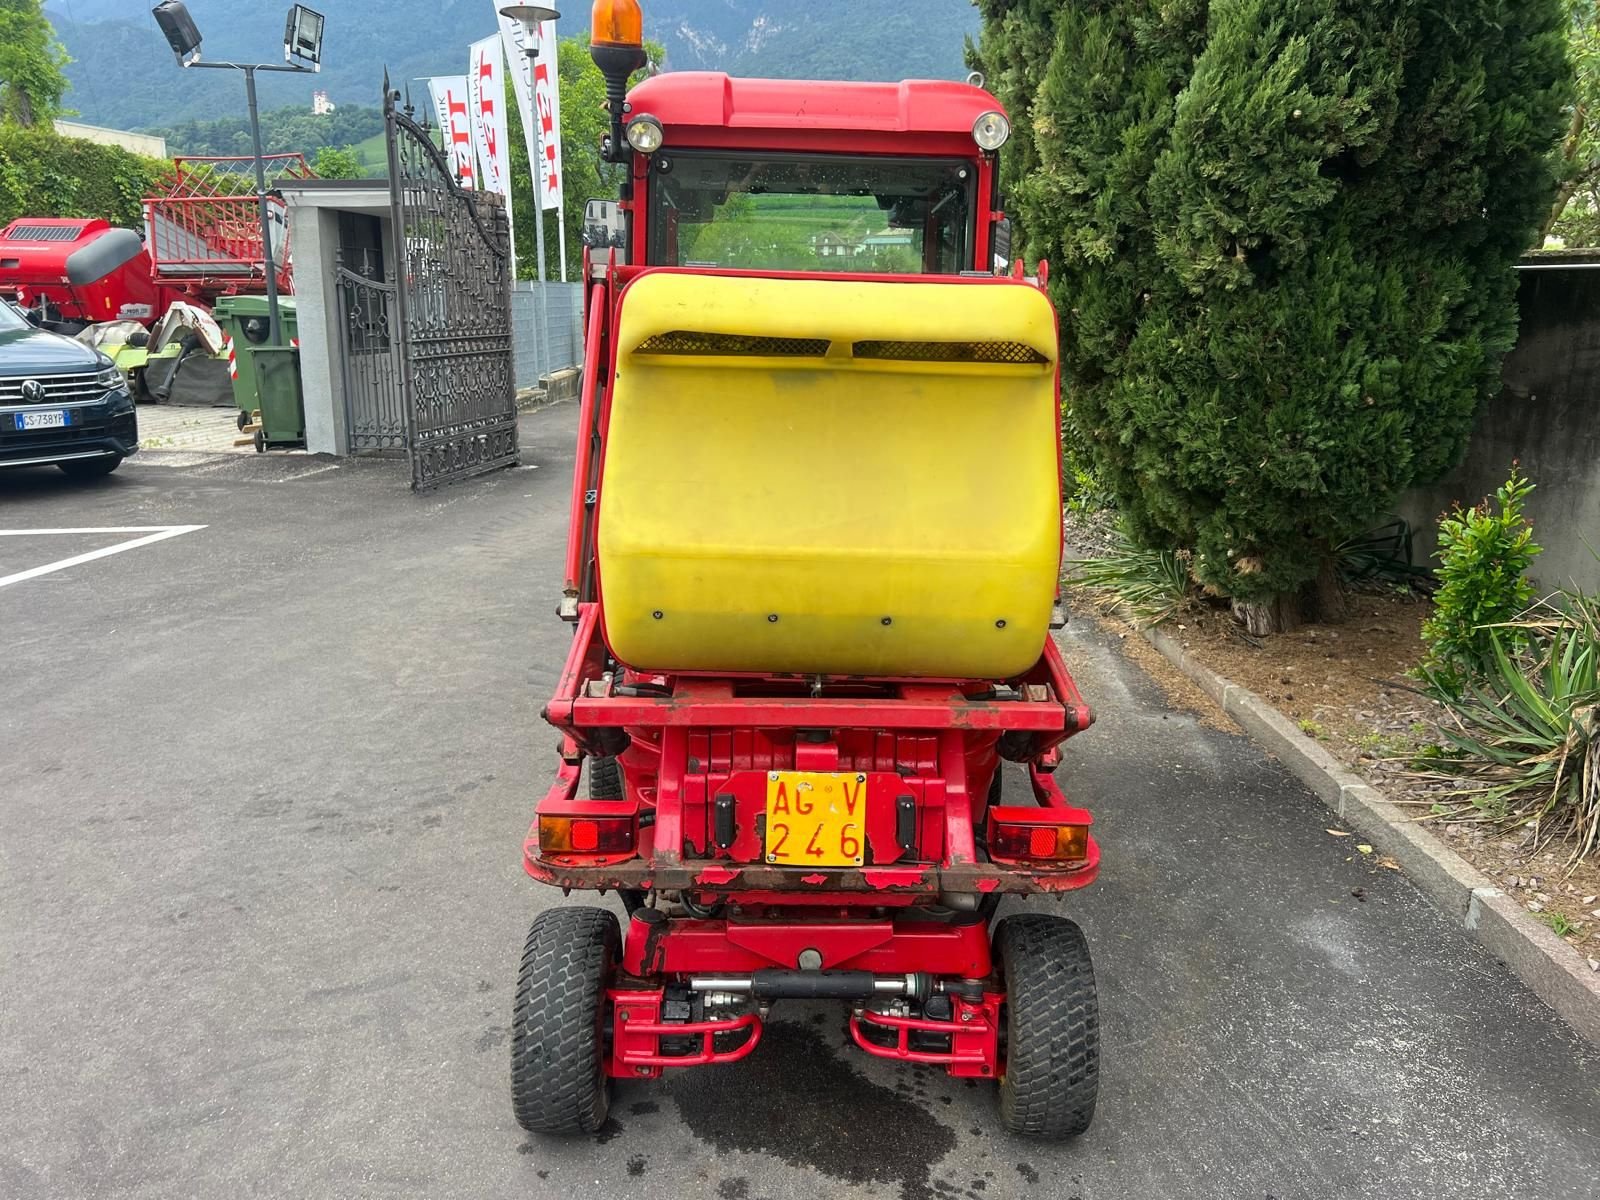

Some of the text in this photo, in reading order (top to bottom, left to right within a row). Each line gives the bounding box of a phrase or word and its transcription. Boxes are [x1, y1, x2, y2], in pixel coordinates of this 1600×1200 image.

[772, 781, 861, 816] AG V
[769, 823, 860, 858] 246
